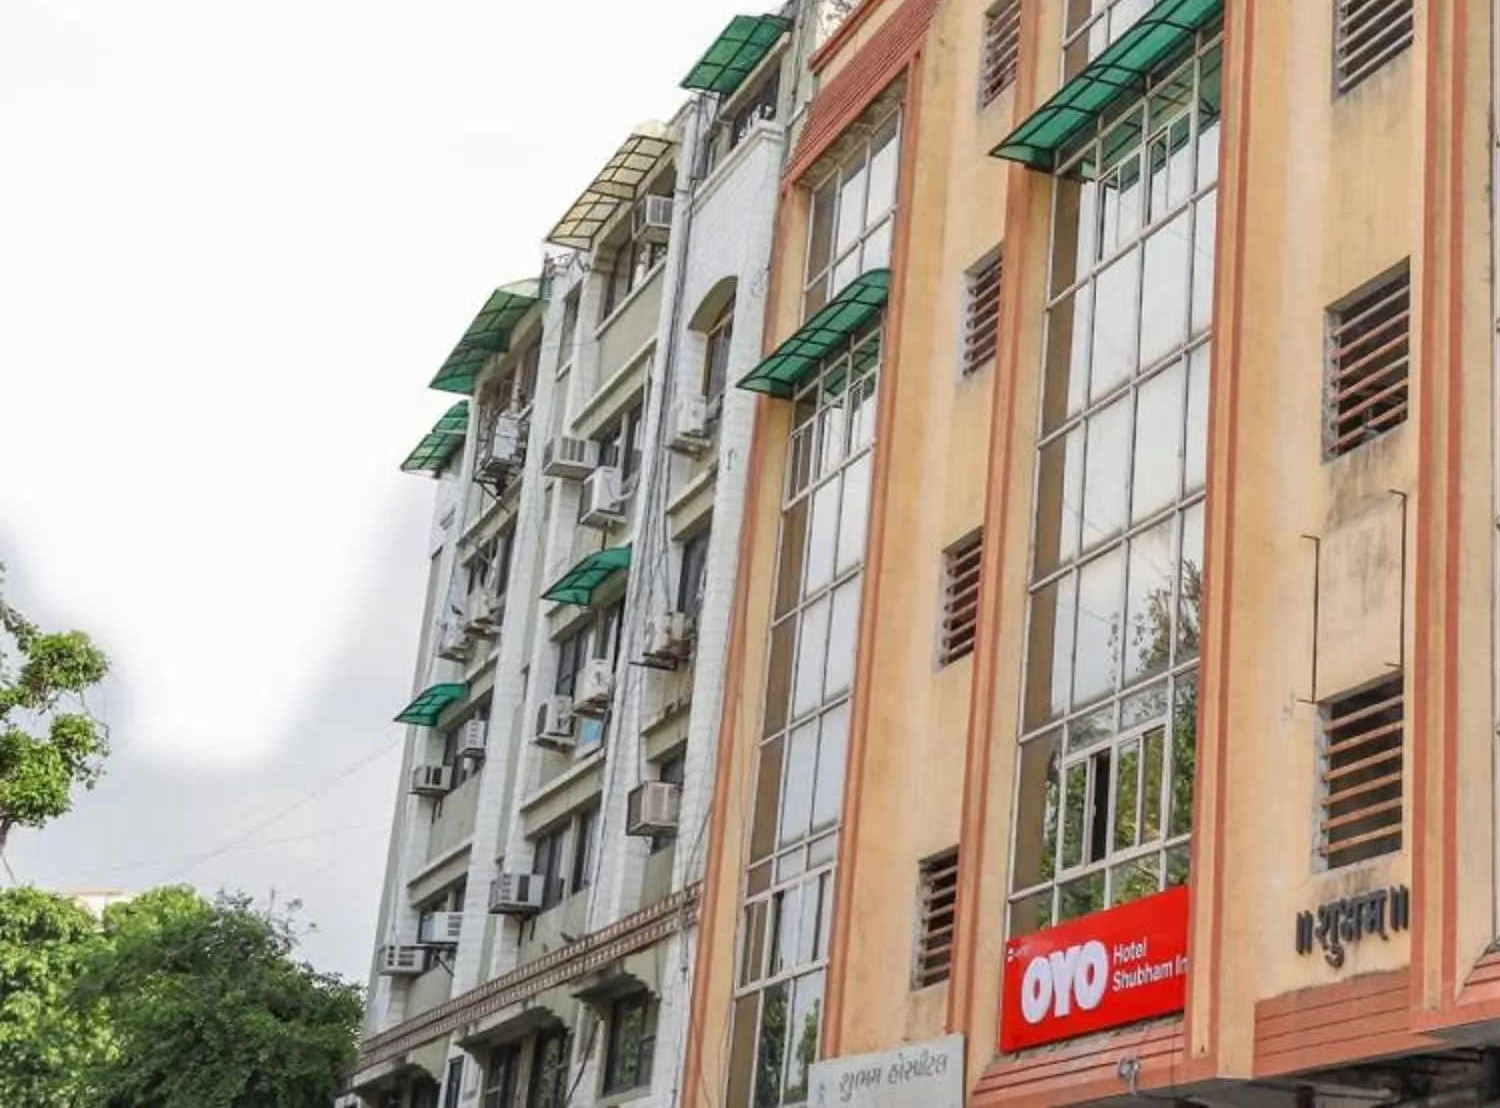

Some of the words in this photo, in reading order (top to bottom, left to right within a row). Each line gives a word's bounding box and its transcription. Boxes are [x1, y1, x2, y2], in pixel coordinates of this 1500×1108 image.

[1113, 937, 1147, 965] Hotel
[1020, 939, 1109, 1024] OYO
[1112, 960, 1173, 991] Shubham
